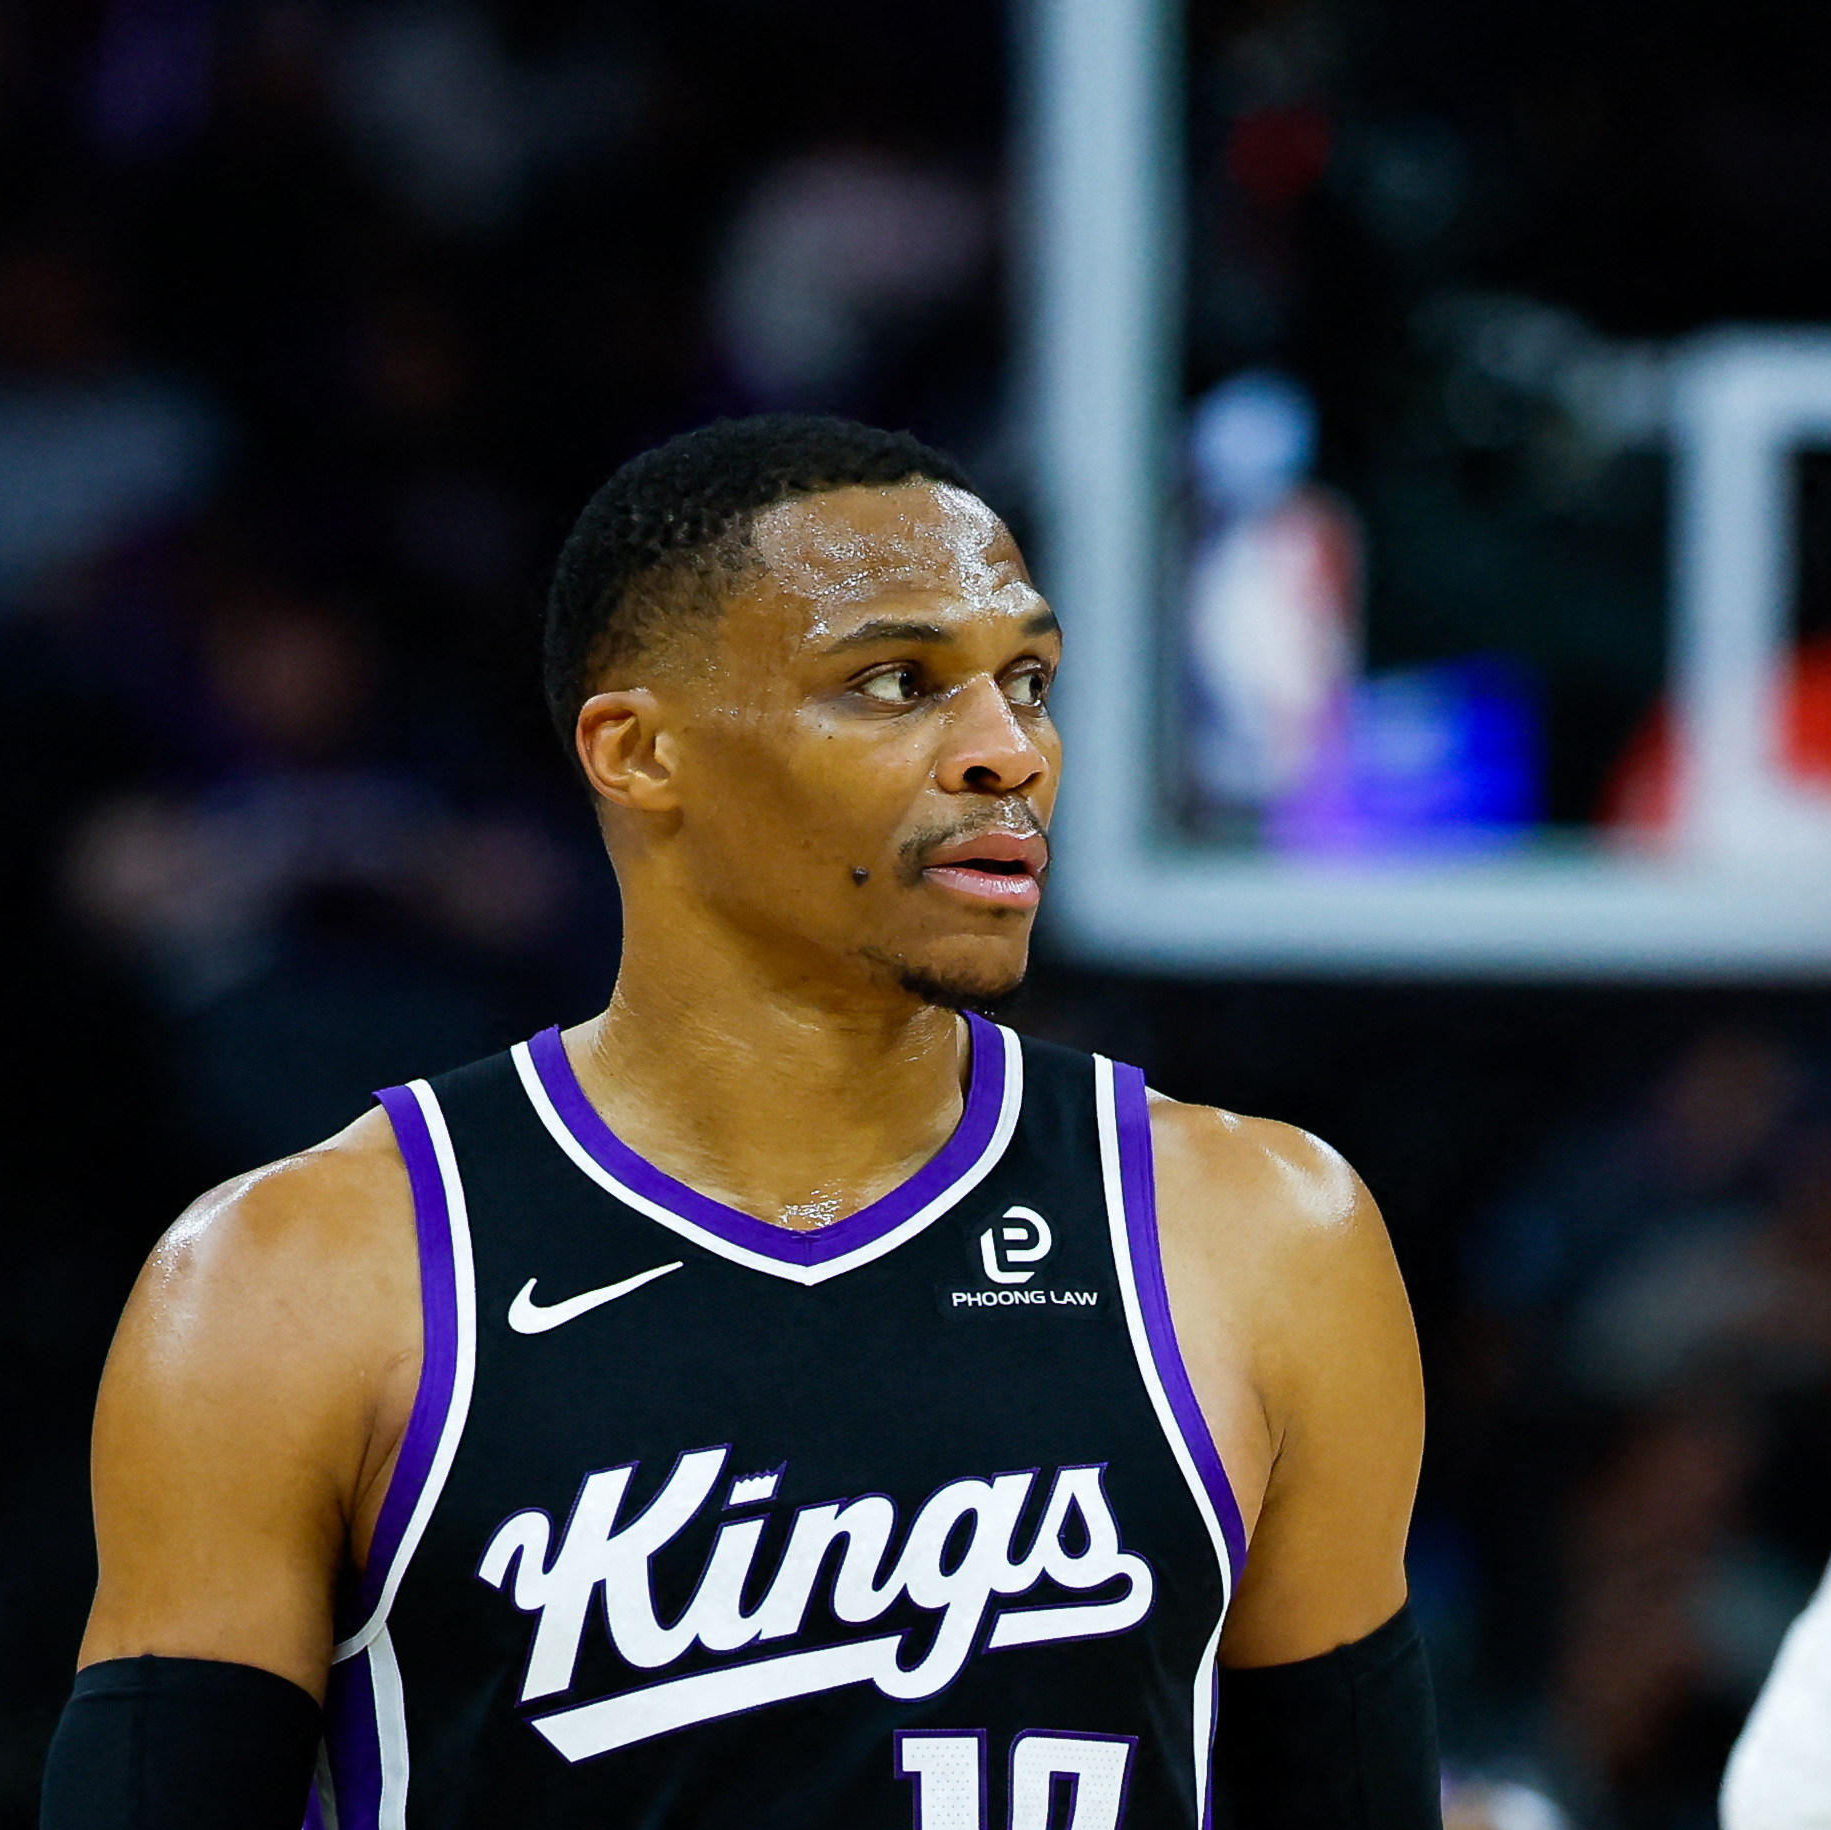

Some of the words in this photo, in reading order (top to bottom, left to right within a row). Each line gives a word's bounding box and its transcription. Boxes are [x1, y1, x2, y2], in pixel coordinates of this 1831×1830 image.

[951, 1290, 1046, 1307] PHOONG
[1050, 1291, 1098, 1306] LAW
[477, 1443, 1157, 1766] Kings
